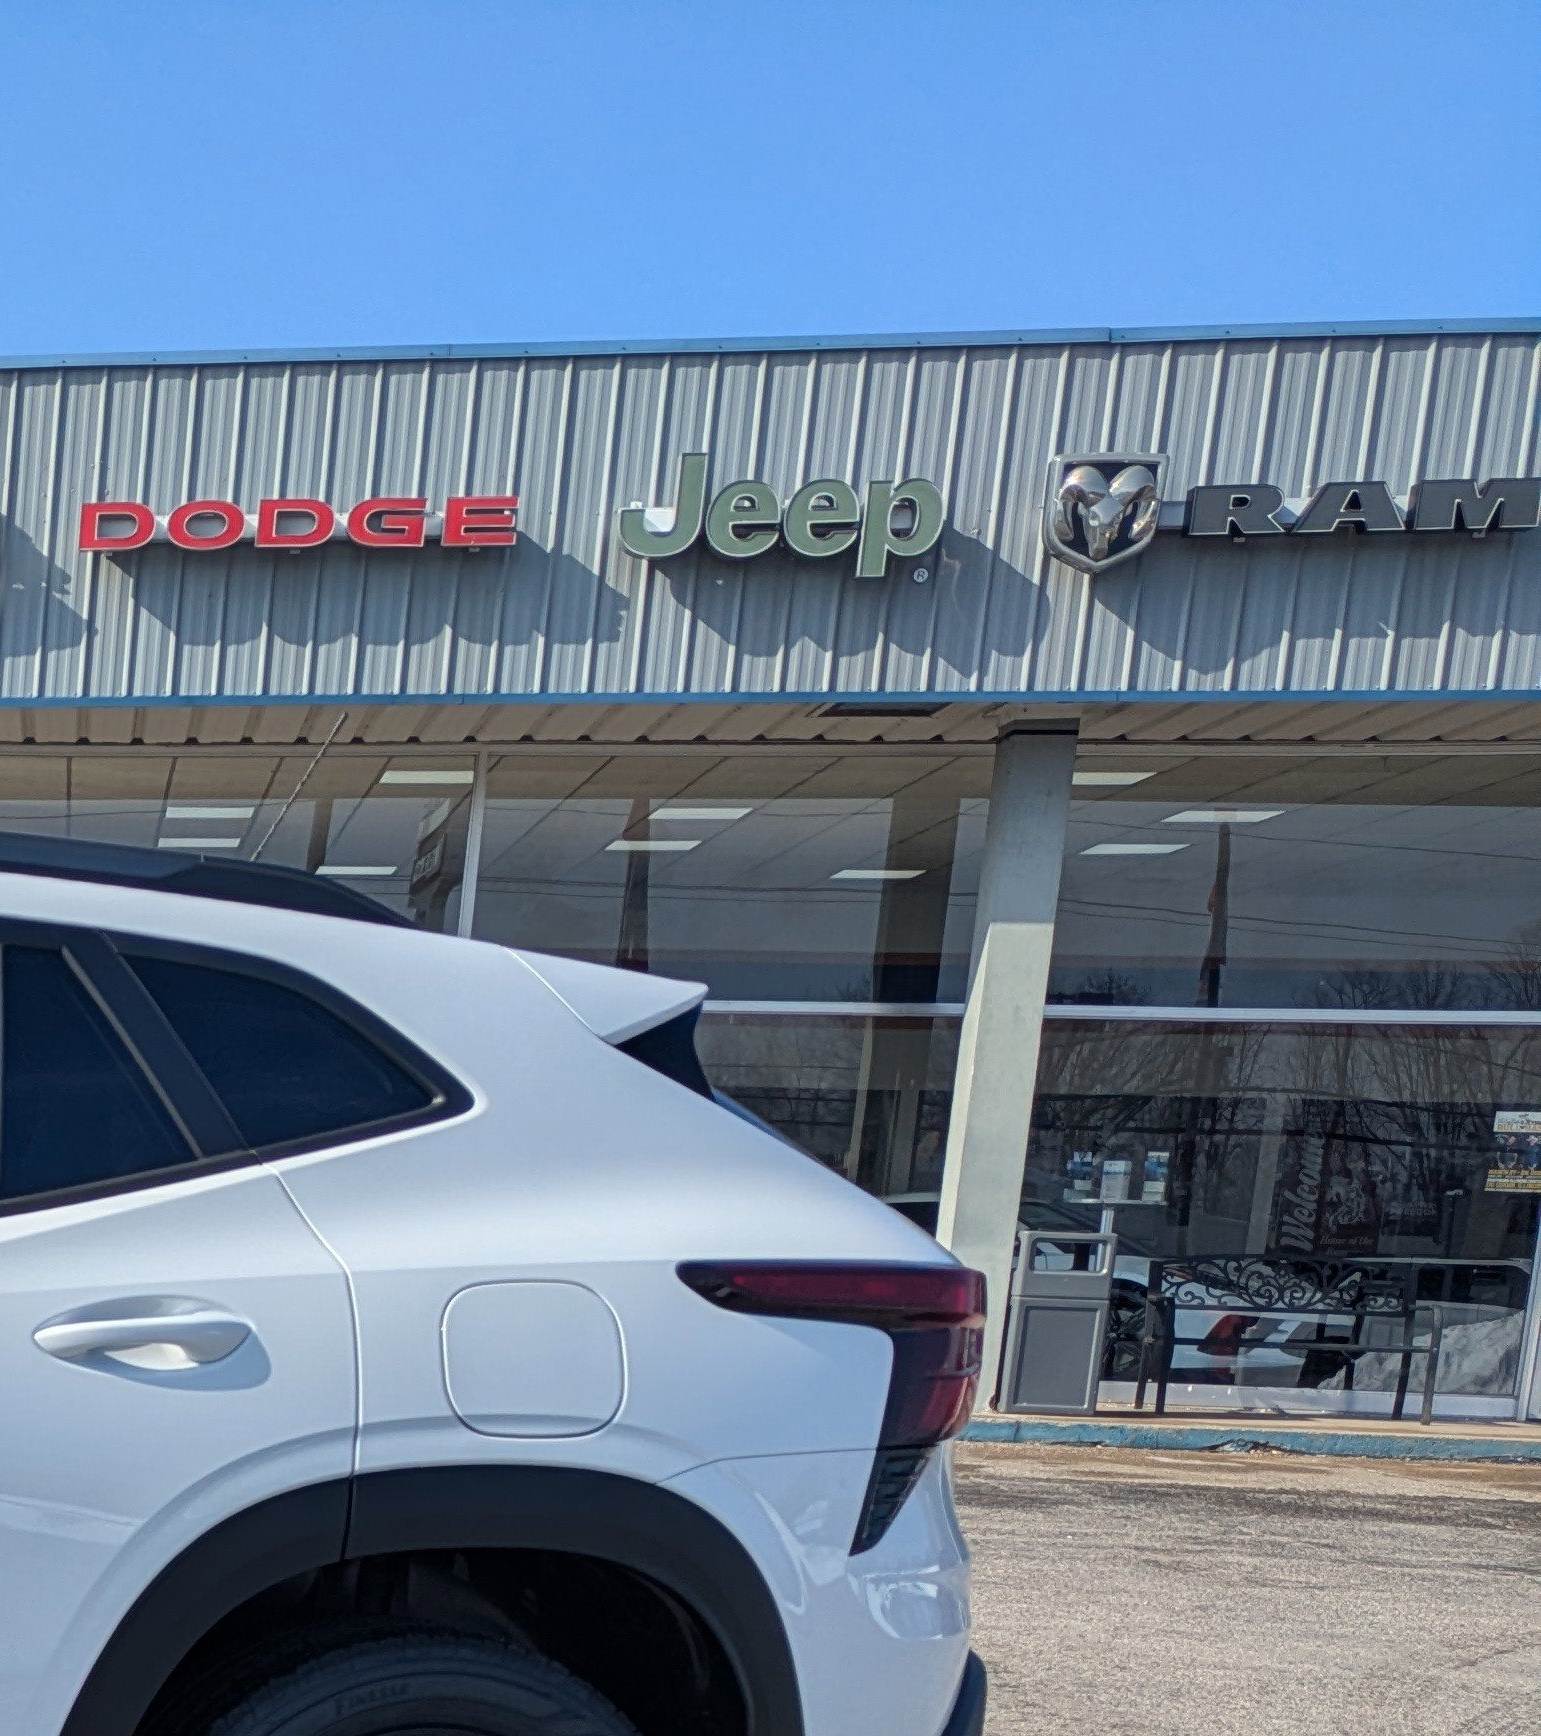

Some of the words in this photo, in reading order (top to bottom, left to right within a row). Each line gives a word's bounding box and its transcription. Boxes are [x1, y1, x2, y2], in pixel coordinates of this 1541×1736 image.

[79, 495, 519, 552] DODGE
[619, 453, 943, 578] Jeep
[1185, 477, 1541, 538] RAM
